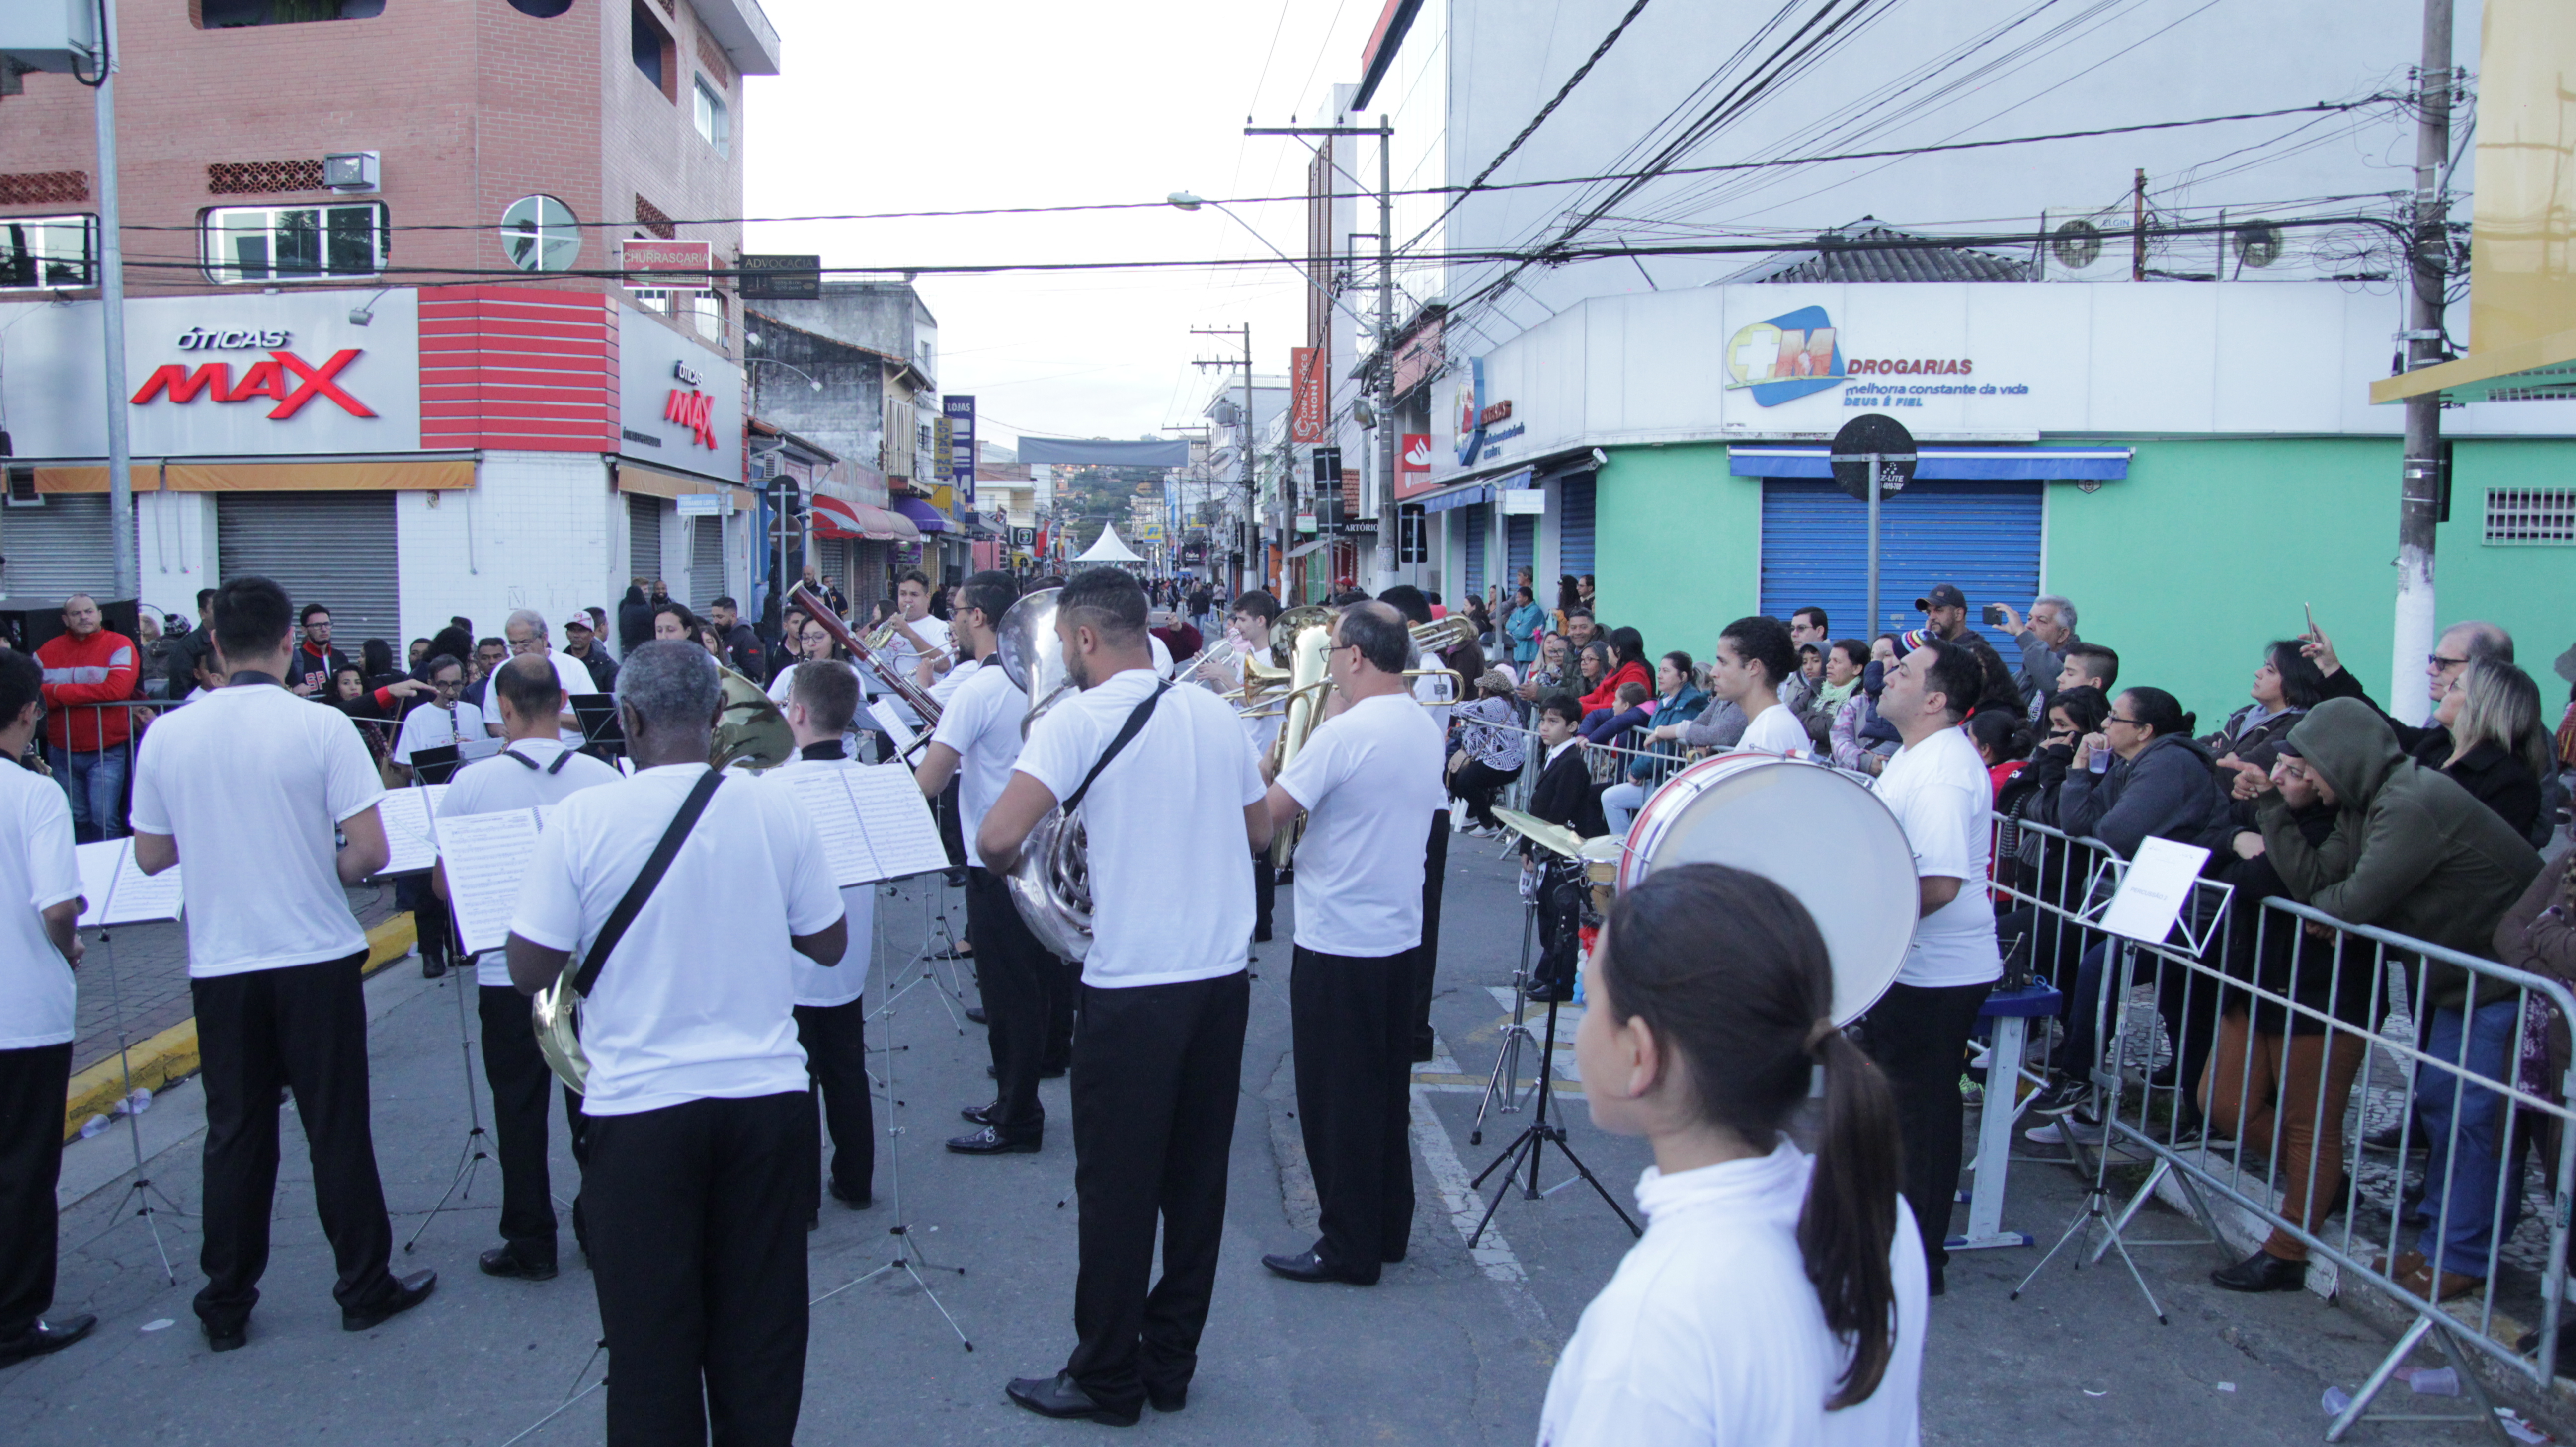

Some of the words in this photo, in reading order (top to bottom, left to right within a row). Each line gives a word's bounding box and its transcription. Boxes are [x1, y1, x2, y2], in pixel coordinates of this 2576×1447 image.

[624, 252, 709, 263] CHURRASCARIA
[745, 258, 813, 268] ADVOCACIA
[176, 327, 294, 350] ÓTICAS
[674, 360, 703, 386] ÓTICAS
[1846, 359, 1973, 375] DROGARIAS
[128, 349, 379, 419] MAX
[1845, 383, 1906, 398] melhoria
[1908, 384, 1977, 395] constante
[1979, 383, 1997, 395] da
[1999, 384, 2029, 395] vida
[947, 402, 971, 412] LOJAS
[1843, 398, 1878, 406] DEUS
[1883, 396, 1891, 406] É
[1895, 398, 1923, 407] FIEL
[663, 389, 719, 451] MAX
[937, 420, 950, 454] LOJAS
[936, 458, 951, 473] MD
[1344, 522, 1379, 532] ARTÓRIO
[2130, 886, 2164, 900] PERCUSSÃO
